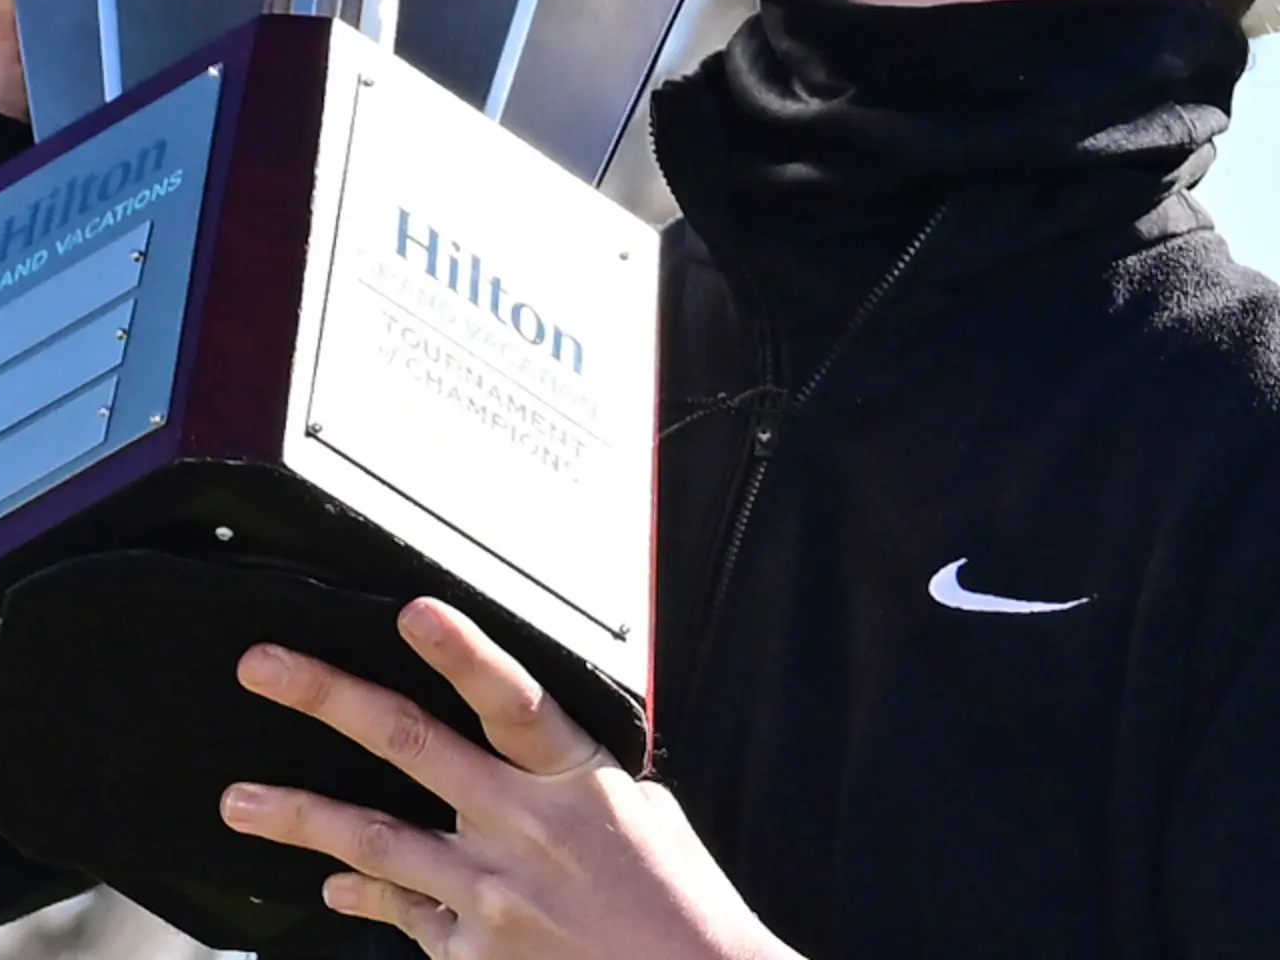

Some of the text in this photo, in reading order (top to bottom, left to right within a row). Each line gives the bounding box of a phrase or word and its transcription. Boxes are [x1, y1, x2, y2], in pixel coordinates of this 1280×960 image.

[55, 168, 183, 256] VACATIONS
[395, 205, 584, 376] Hilton
[380, 308, 587, 459] TOURNAMENT
[465, 314, 608, 420] VACATION
